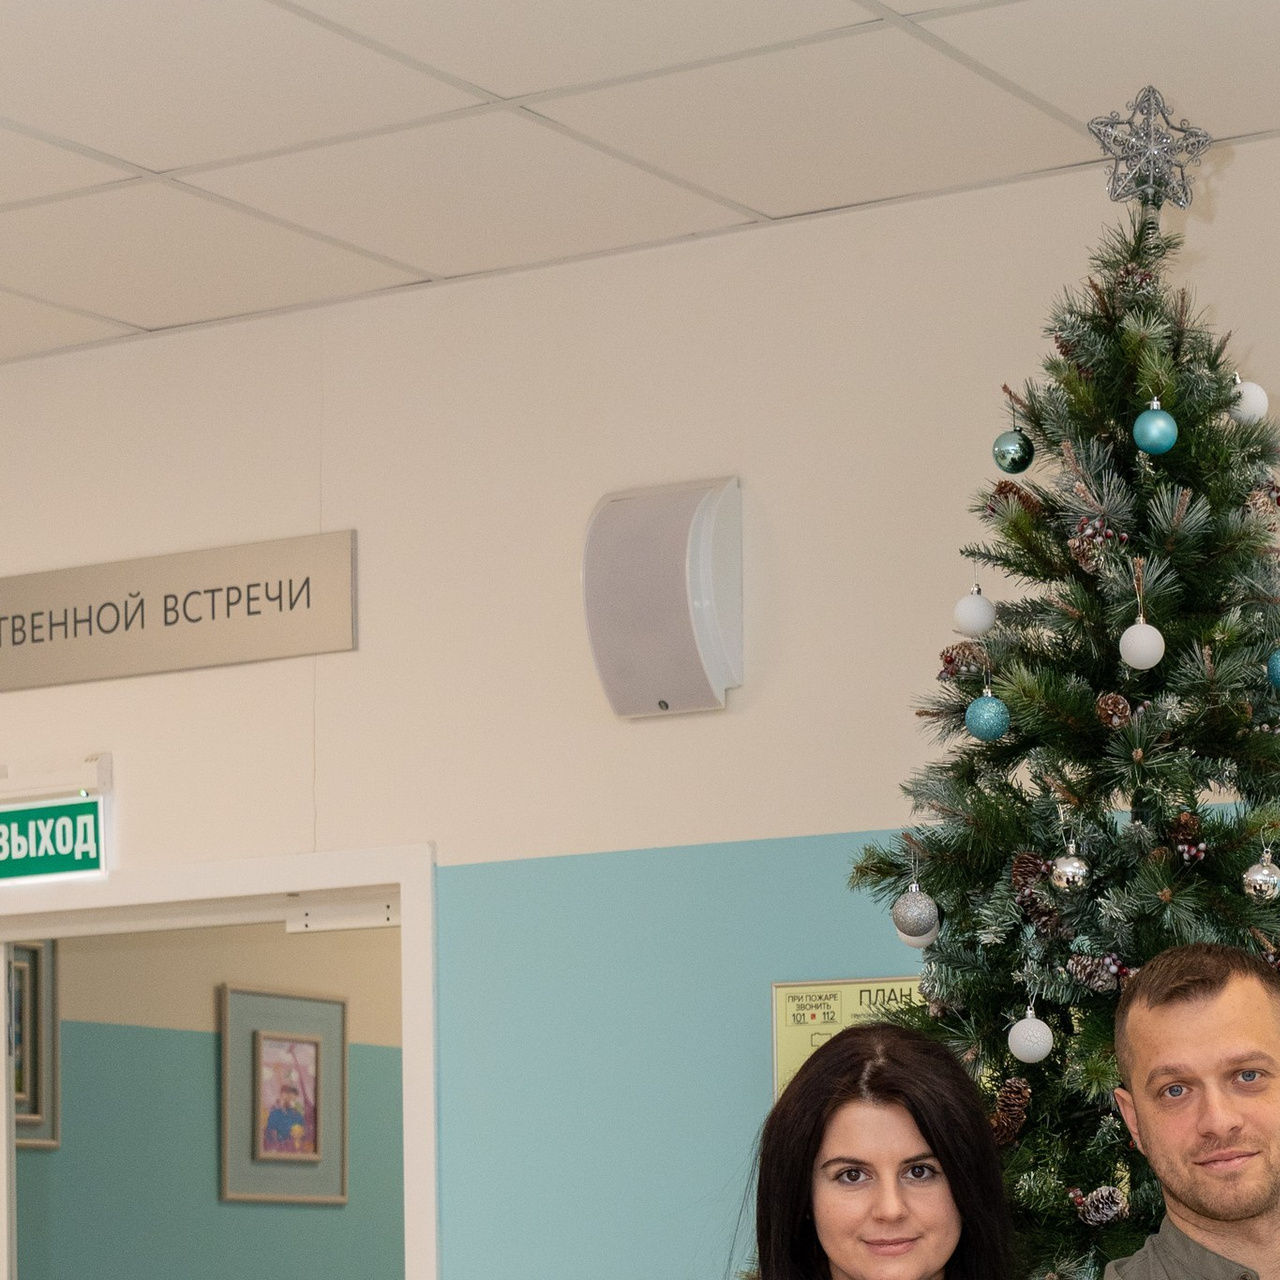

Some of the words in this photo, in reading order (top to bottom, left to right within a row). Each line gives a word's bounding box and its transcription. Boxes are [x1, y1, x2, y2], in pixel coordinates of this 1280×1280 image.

[163, 576, 312, 627] ВСТРЕЧИ
[787, 995, 804, 1003] ПРИ
[805, 993, 838, 1002] ПОЖАРЕ
[859, 987, 912, 1006] ПЛАН
[795, 1002, 832, 1011] ЗВОНИТЬ
[792, 1013, 806, 1023] 101
[822, 1011, 836, 1021] 112
